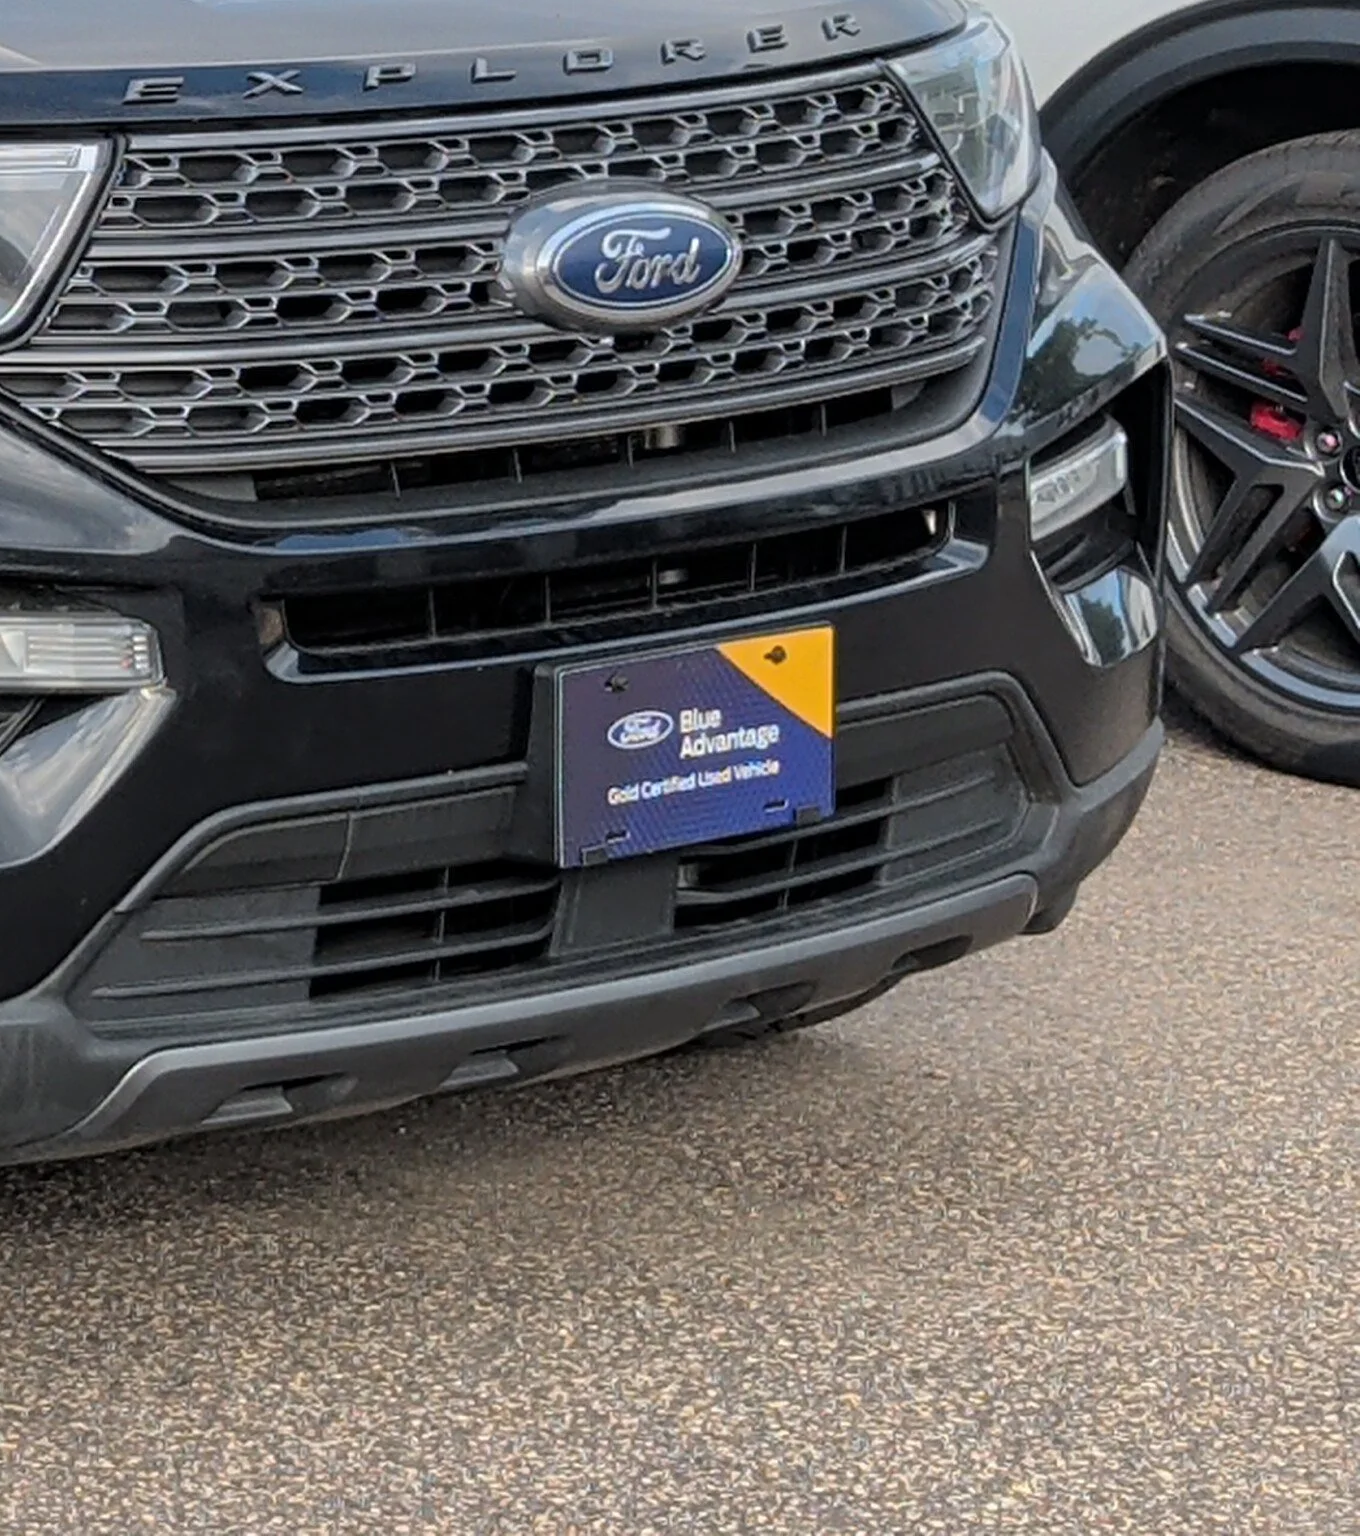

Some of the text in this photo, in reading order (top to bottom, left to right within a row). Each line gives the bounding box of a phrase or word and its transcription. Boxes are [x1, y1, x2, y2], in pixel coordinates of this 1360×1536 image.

[121, 12, 863, 105] EXPLORER
[594, 226, 701, 294] Ford
[680, 708, 722, 733] Blue
[680, 724, 779, 759] Advantage
[607, 759, 780, 806] Gold Certified Used Vehicle
